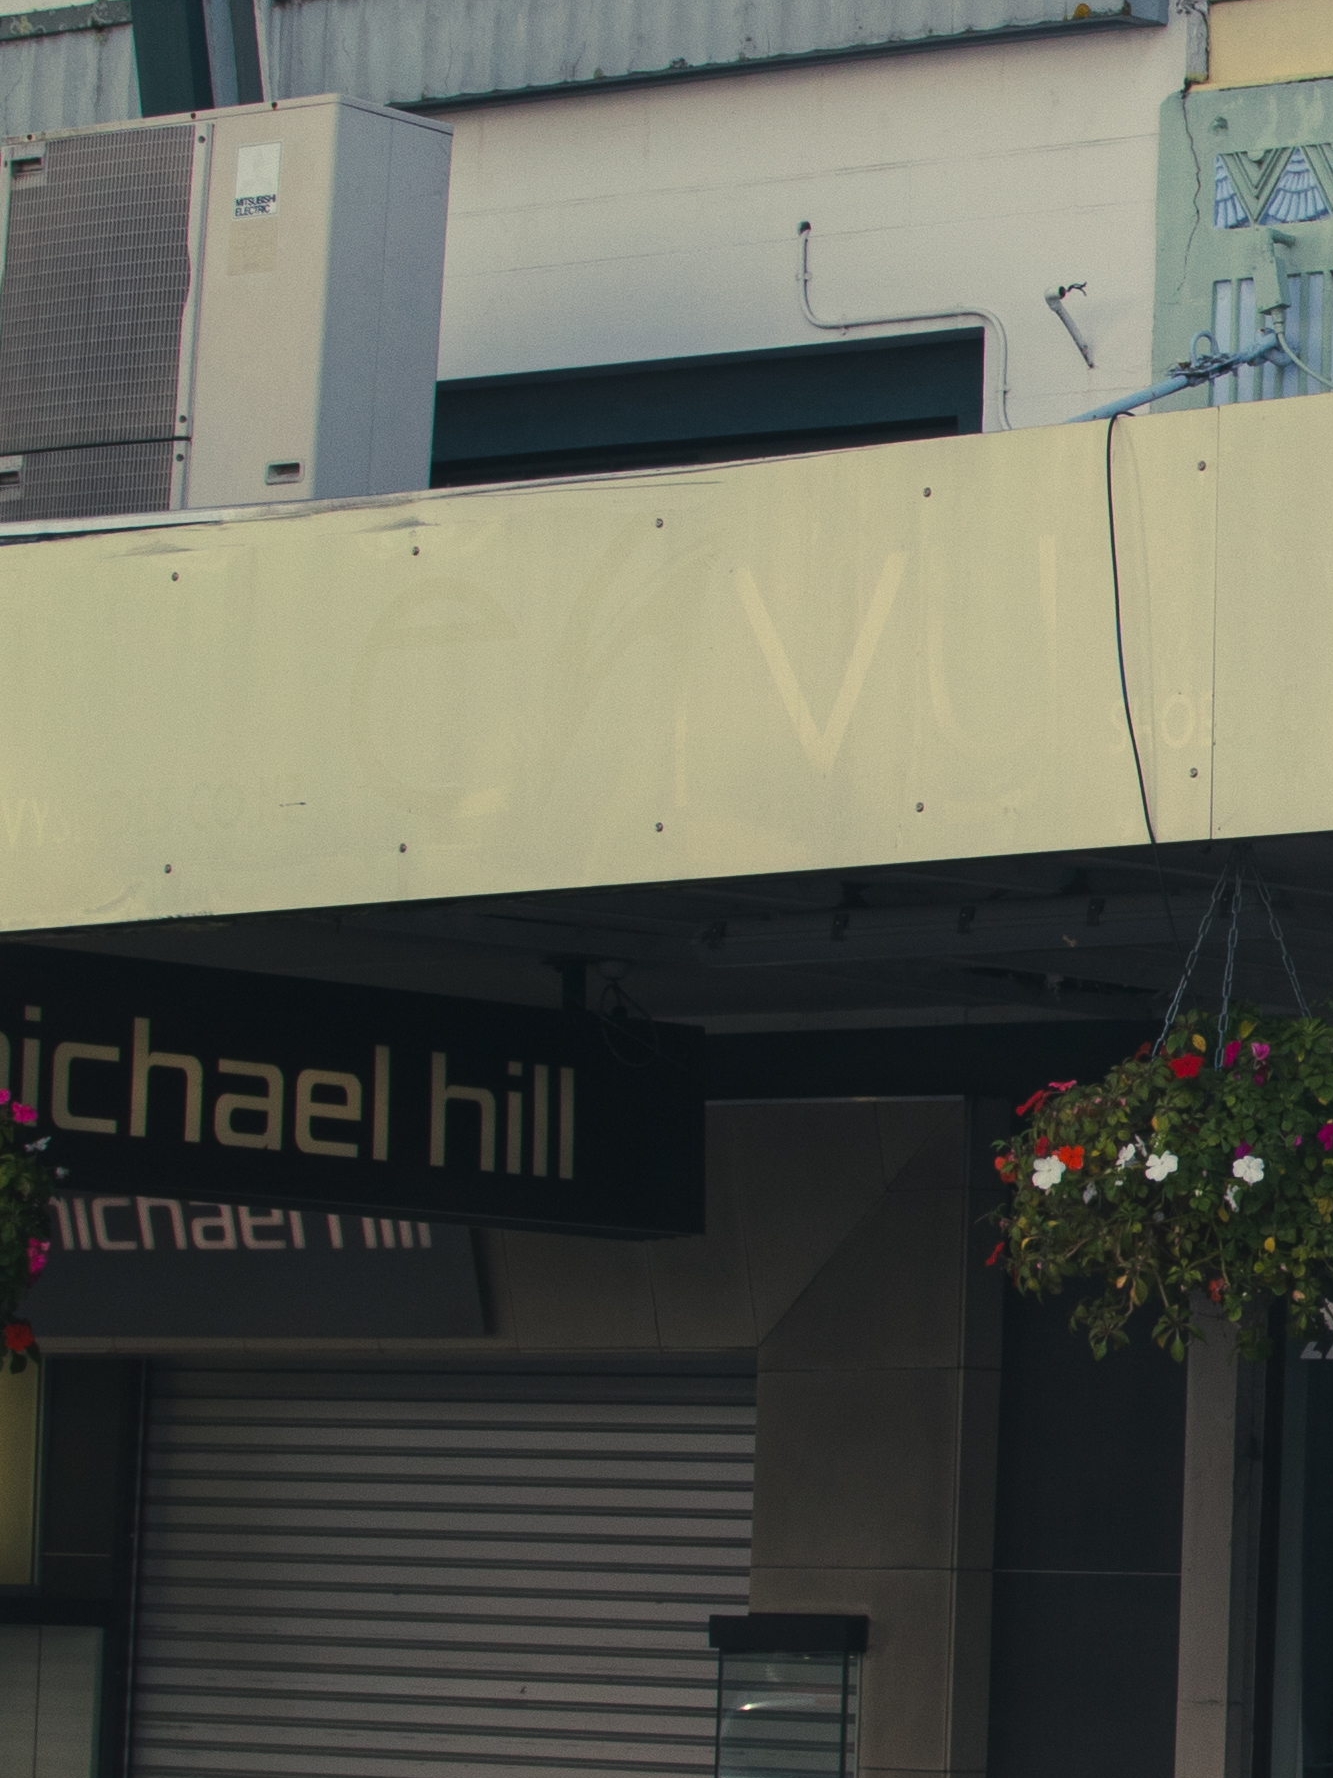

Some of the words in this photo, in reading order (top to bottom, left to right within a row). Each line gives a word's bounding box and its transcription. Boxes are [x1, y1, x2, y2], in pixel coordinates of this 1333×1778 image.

[234, 204, 271, 217] ELECTRIC
[0, 1005, 391, 1162] ichael
[429, 1051, 575, 1180] hill
